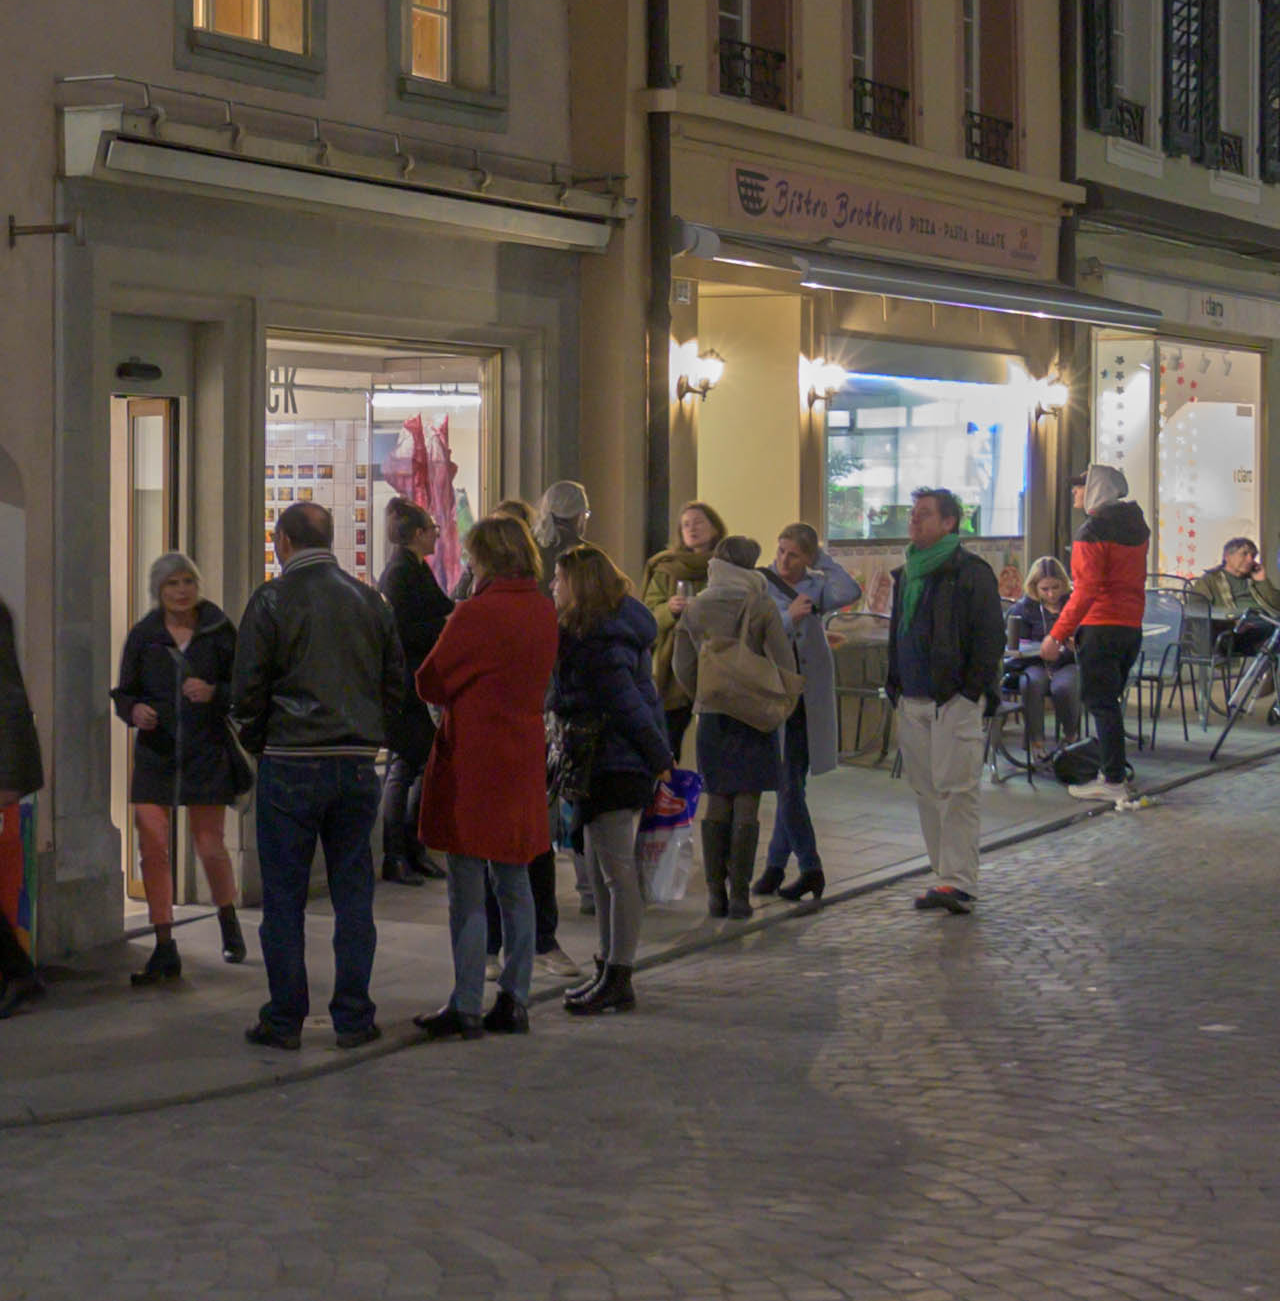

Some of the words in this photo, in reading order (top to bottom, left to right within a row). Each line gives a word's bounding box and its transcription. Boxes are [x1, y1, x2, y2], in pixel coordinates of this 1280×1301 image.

[771, 180, 828, 218] Bistro
[833, 191, 903, 235] Brotkorb
[910, 215, 936, 236] PIZZA
[943, 222, 969, 243] PASTA
[975, 227, 1006, 251] SALATE
